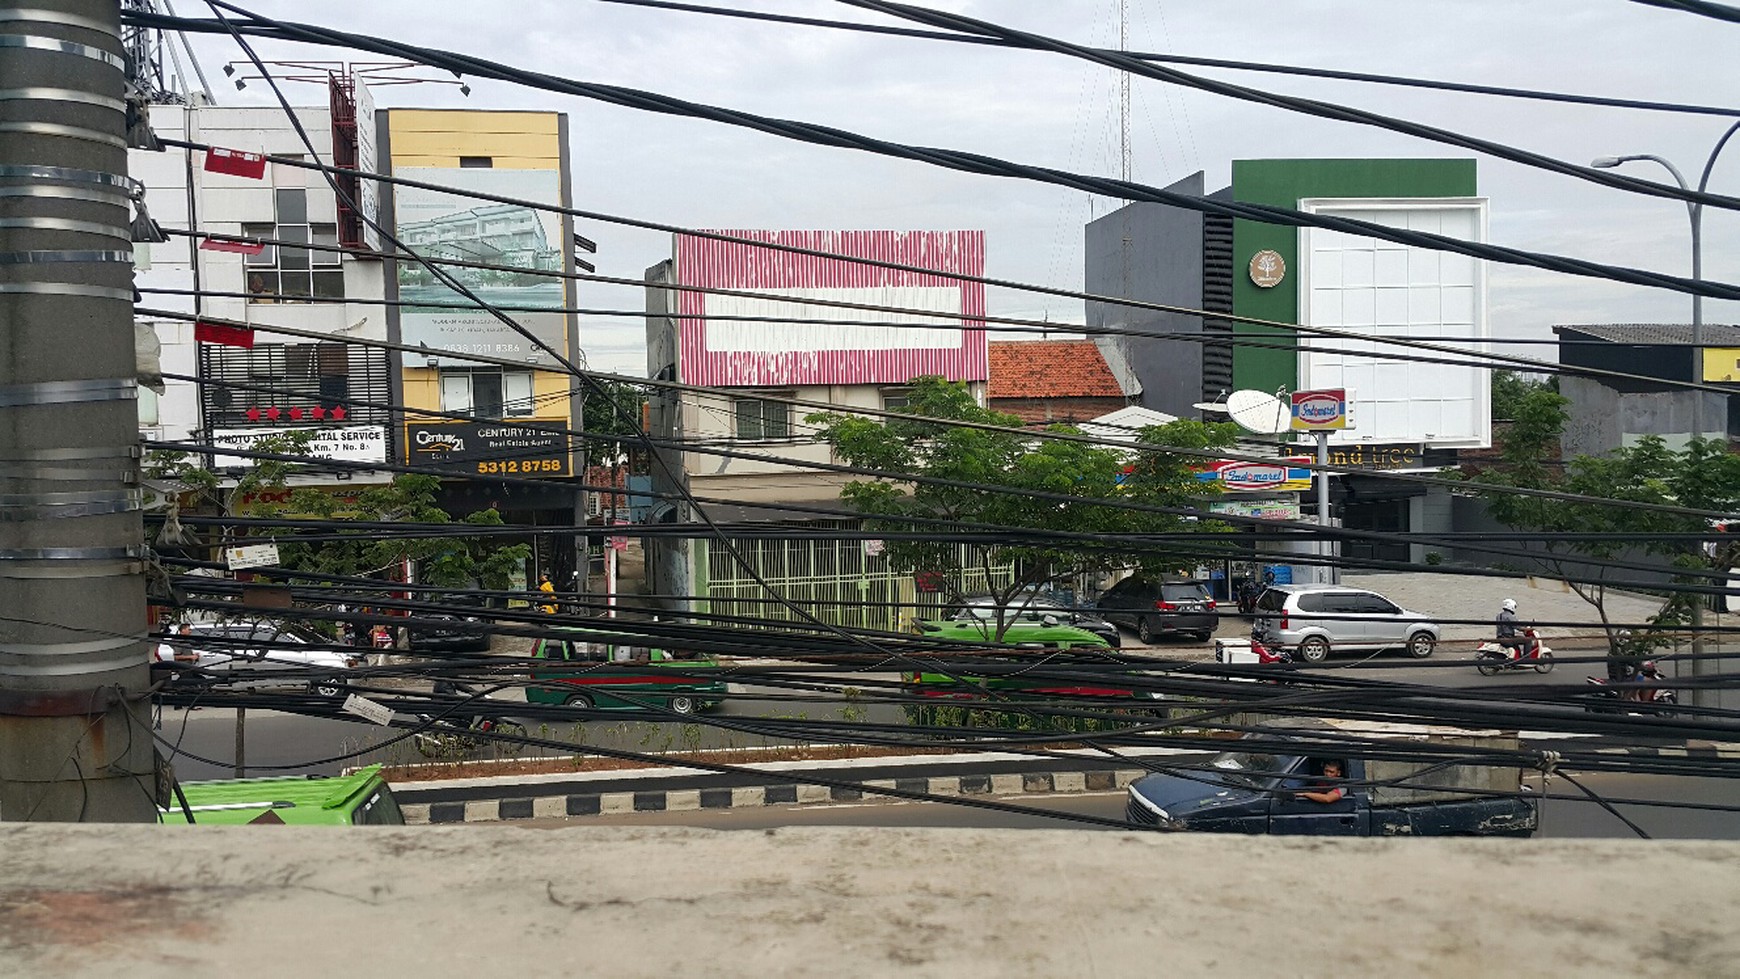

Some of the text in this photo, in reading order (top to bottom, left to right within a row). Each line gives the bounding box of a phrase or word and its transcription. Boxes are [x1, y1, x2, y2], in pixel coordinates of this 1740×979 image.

[472, 344, 491, 353] 1211
[1301, 403, 1336, 416] Indomaret
[217, 434, 251, 444] PHOTO
[340, 431, 381, 440] SERVICE
[416, 430, 455, 444] Century
[477, 427, 524, 438] CENTURY
[526, 428, 536, 436] 21
[313, 443, 331, 452] Km.
[333, 443, 340, 451] 7
[342, 443, 357, 451] No.
[452, 438, 466, 451] 21
[1372, 446, 1415, 464] tree
[477, 459, 562, 473] 5312 8758
[1226, 470, 1282, 481] Indomaret
